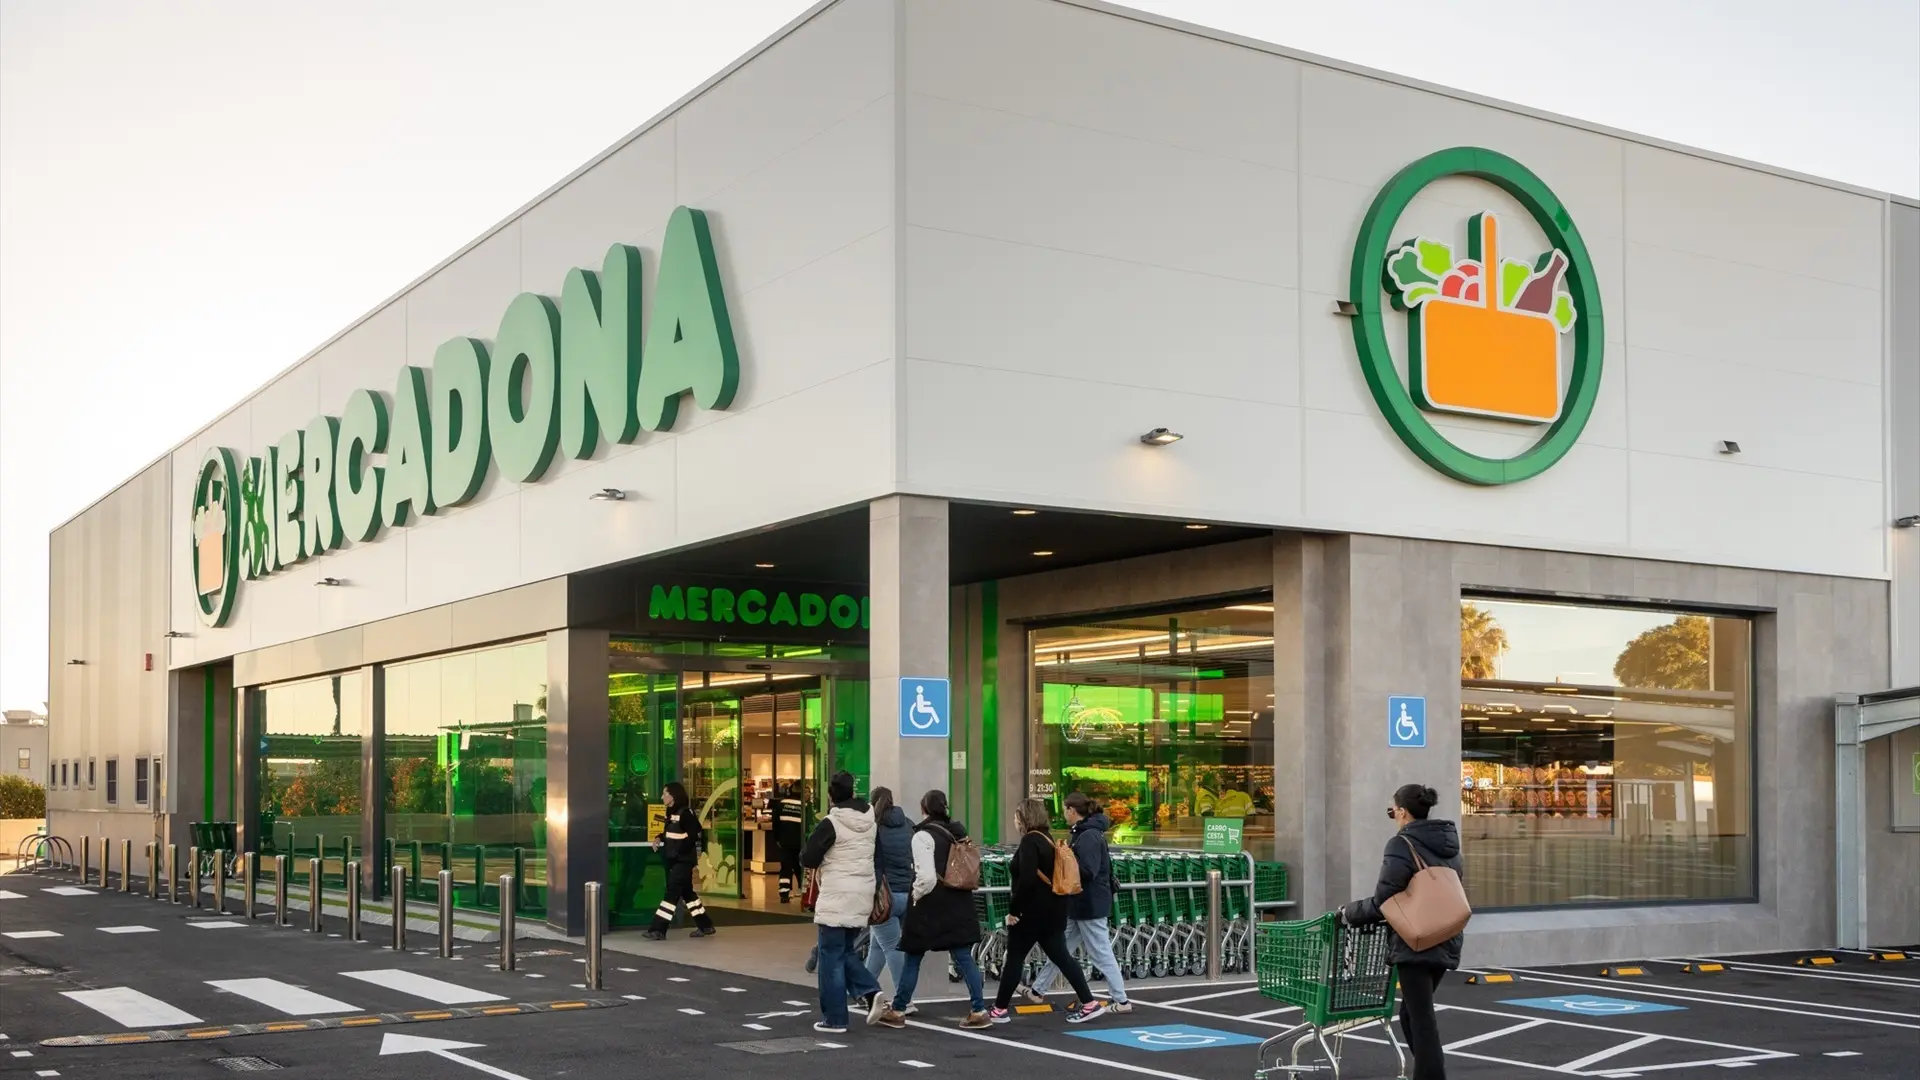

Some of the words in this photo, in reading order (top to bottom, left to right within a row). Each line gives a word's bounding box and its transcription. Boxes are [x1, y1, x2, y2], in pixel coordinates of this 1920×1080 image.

[240, 205, 740, 580] MERCADONA
[649, 584, 870, 629] MERCADO
[1037, 783, 1053, 792] 21:30
[1207, 824, 1227, 832] CARRO
